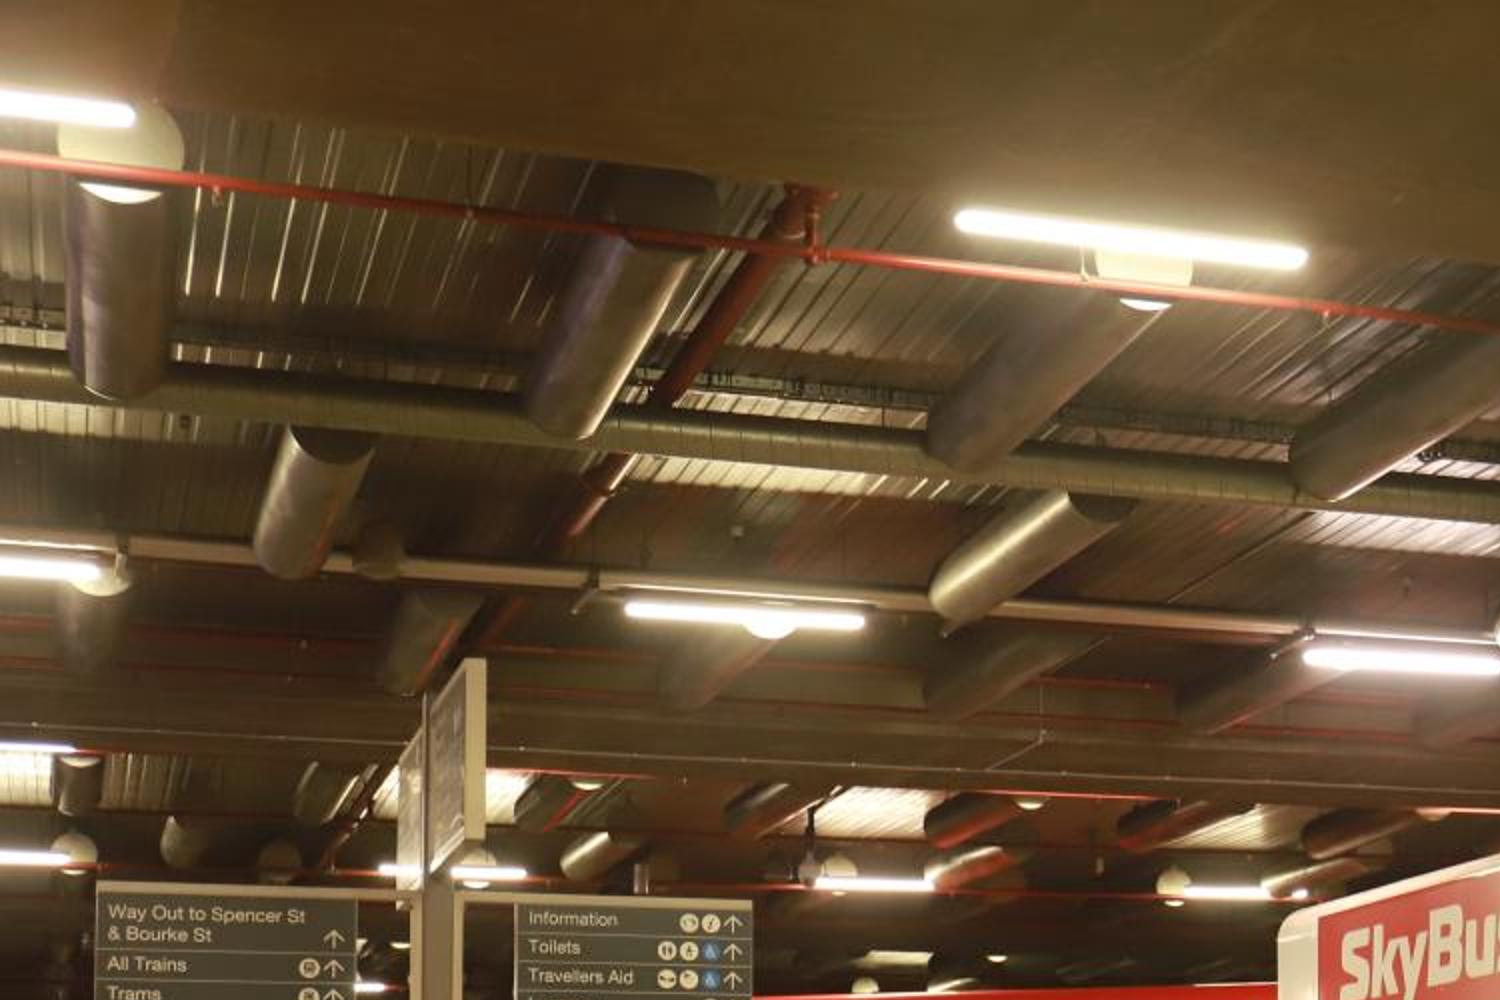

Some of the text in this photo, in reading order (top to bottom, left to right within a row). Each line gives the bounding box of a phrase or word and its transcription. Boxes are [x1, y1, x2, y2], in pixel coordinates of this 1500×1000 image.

[108, 903, 305, 924] Way Out to Spencer St
[528, 911, 618, 927] Information
[107, 926, 213, 942] & Bourke St
[528, 939, 581, 955] Toilets
[107, 956, 187, 972] All Trains
[528, 967, 634, 985] Travellers Aid
